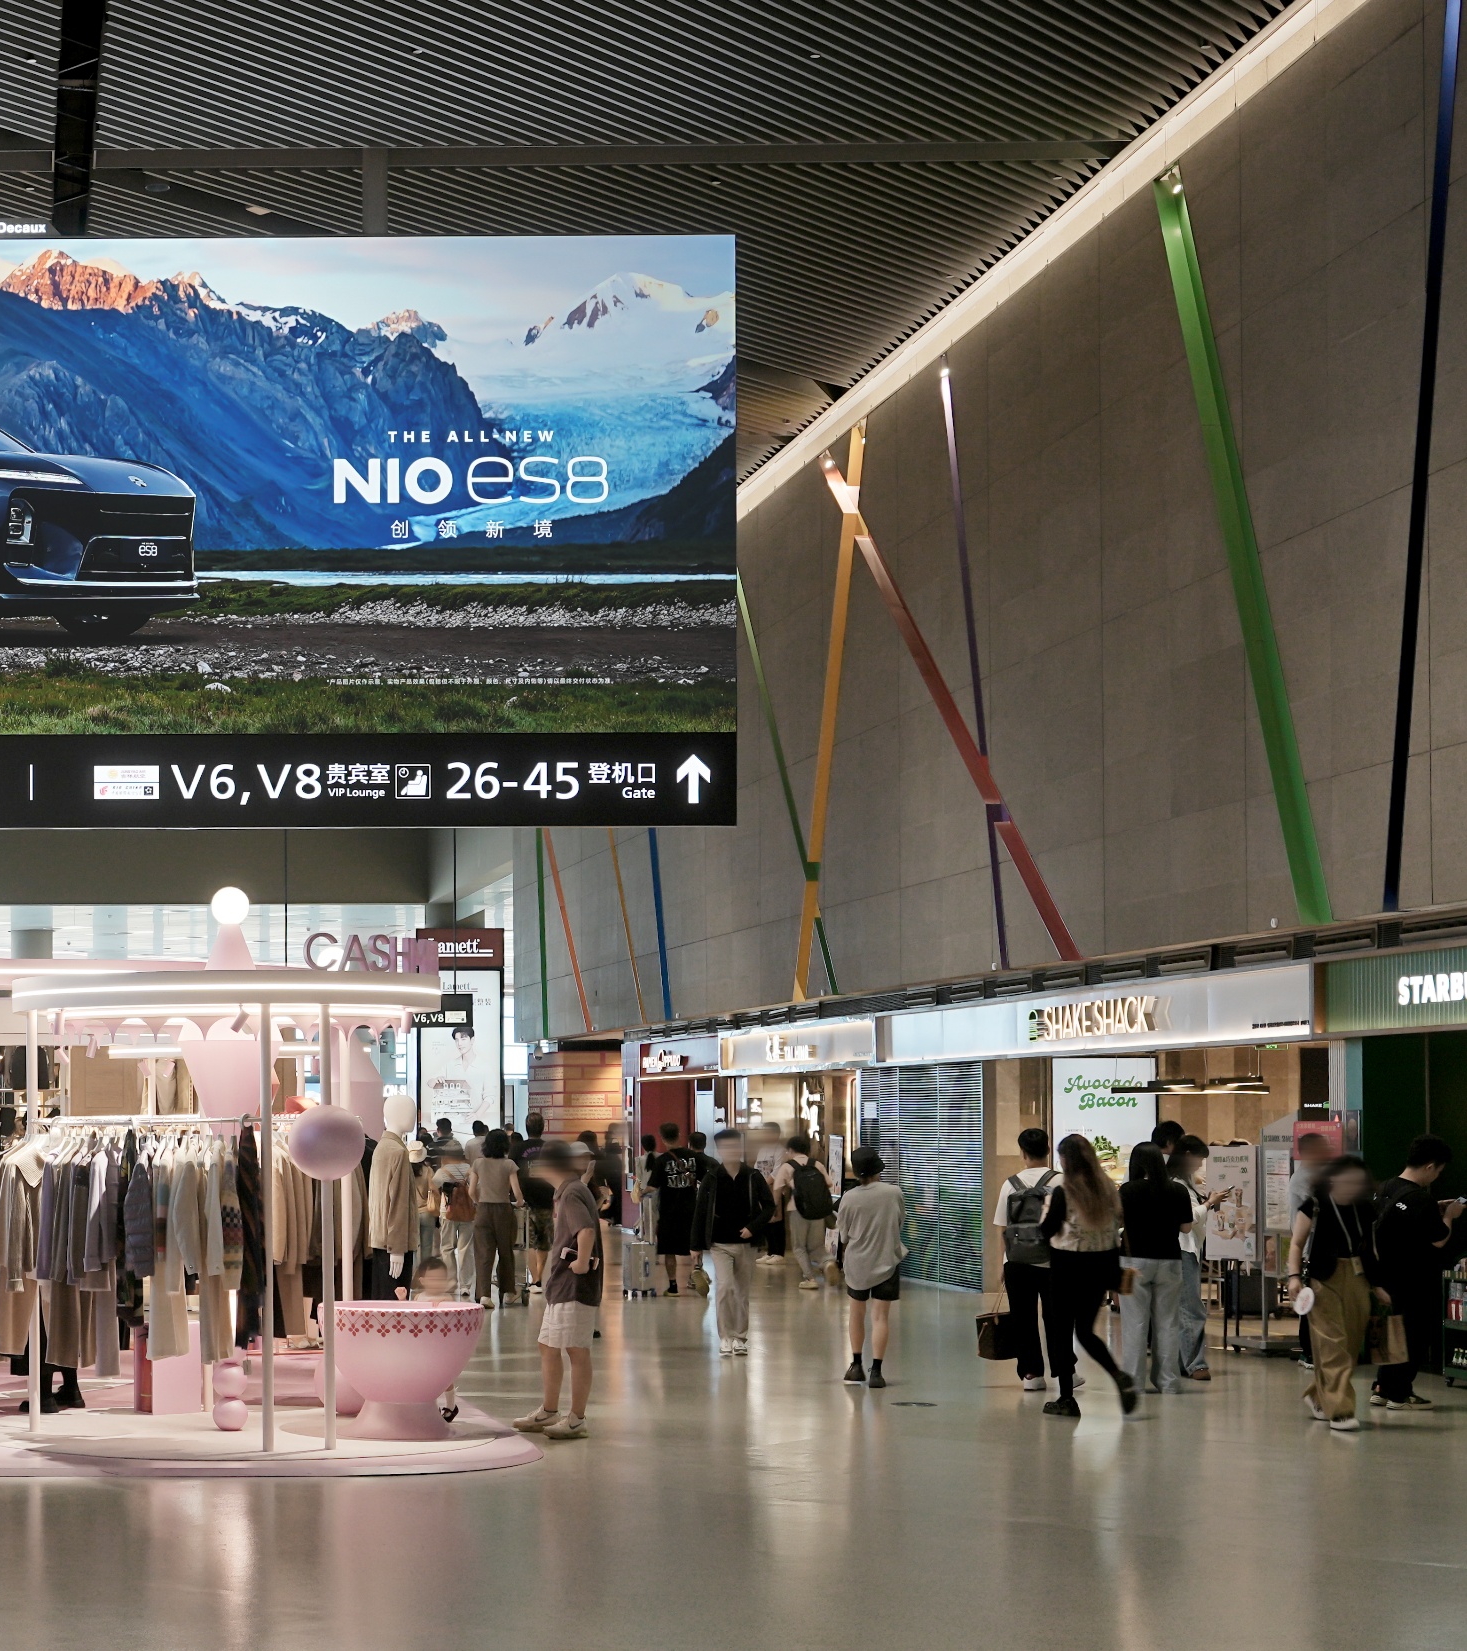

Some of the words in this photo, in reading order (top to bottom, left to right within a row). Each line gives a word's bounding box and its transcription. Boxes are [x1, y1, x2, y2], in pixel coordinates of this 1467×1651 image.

[388, 431, 431, 442] THE
[447, 430, 555, 443] ALL-NEW
[333, 457, 453, 504] NIO
[391, 520, 554, 539] 创领新境
[326, 763, 391, 784] 贵宾室
[446, 762, 580, 799] 26-45
[588, 762, 656, 784] 登机口
[171, 763, 322, 805] V6,V8
[622, 787, 656, 799] Gate
[328, 788, 346, 797] VIP
[349, 788, 386, 799] Lounge
[428, 938, 480, 953] amett
[442, 982, 471, 991] Lamett
[1398, 972, 1467, 1005] STARB
[413, 1013, 444, 1024] V6,V8
[1044, 1002, 1092, 1041] SHAKE
[1094, 996, 1149, 1034] SHACK
[1064, 1075, 1143, 1093] Avocado
[1078, 1093, 1138, 1110] Bacon
